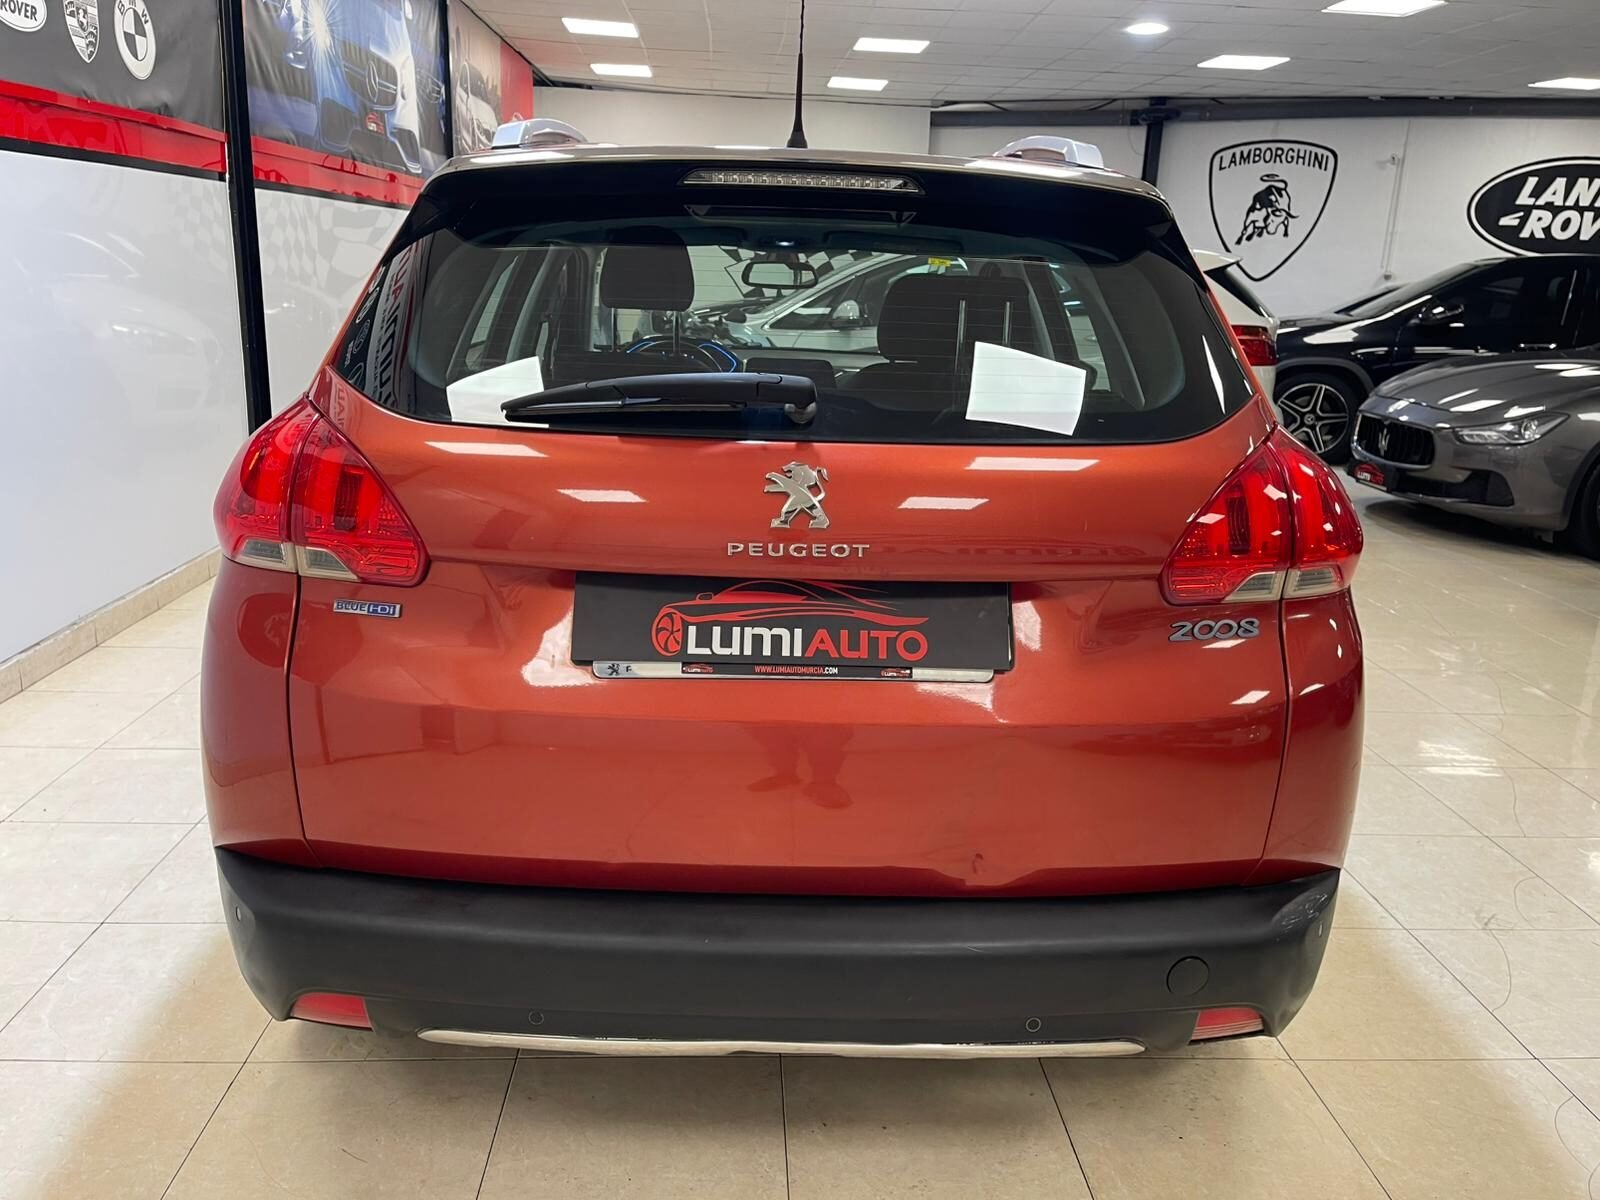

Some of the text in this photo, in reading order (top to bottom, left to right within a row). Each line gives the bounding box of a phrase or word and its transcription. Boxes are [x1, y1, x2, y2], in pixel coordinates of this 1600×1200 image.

[0, 0, 38, 22] ROVER
[1218, 147, 1329, 171] LAMBORGHINI
[1518, 209, 1600, 241] ROV
[727, 542, 870, 558] PEUGEOT
[1168, 617, 1260, 641] 2008
[687, 625, 929, 661] LUMIAUTO
[754, 665, 838, 675] WWW.LUMIAUTOMURCIA.COM
